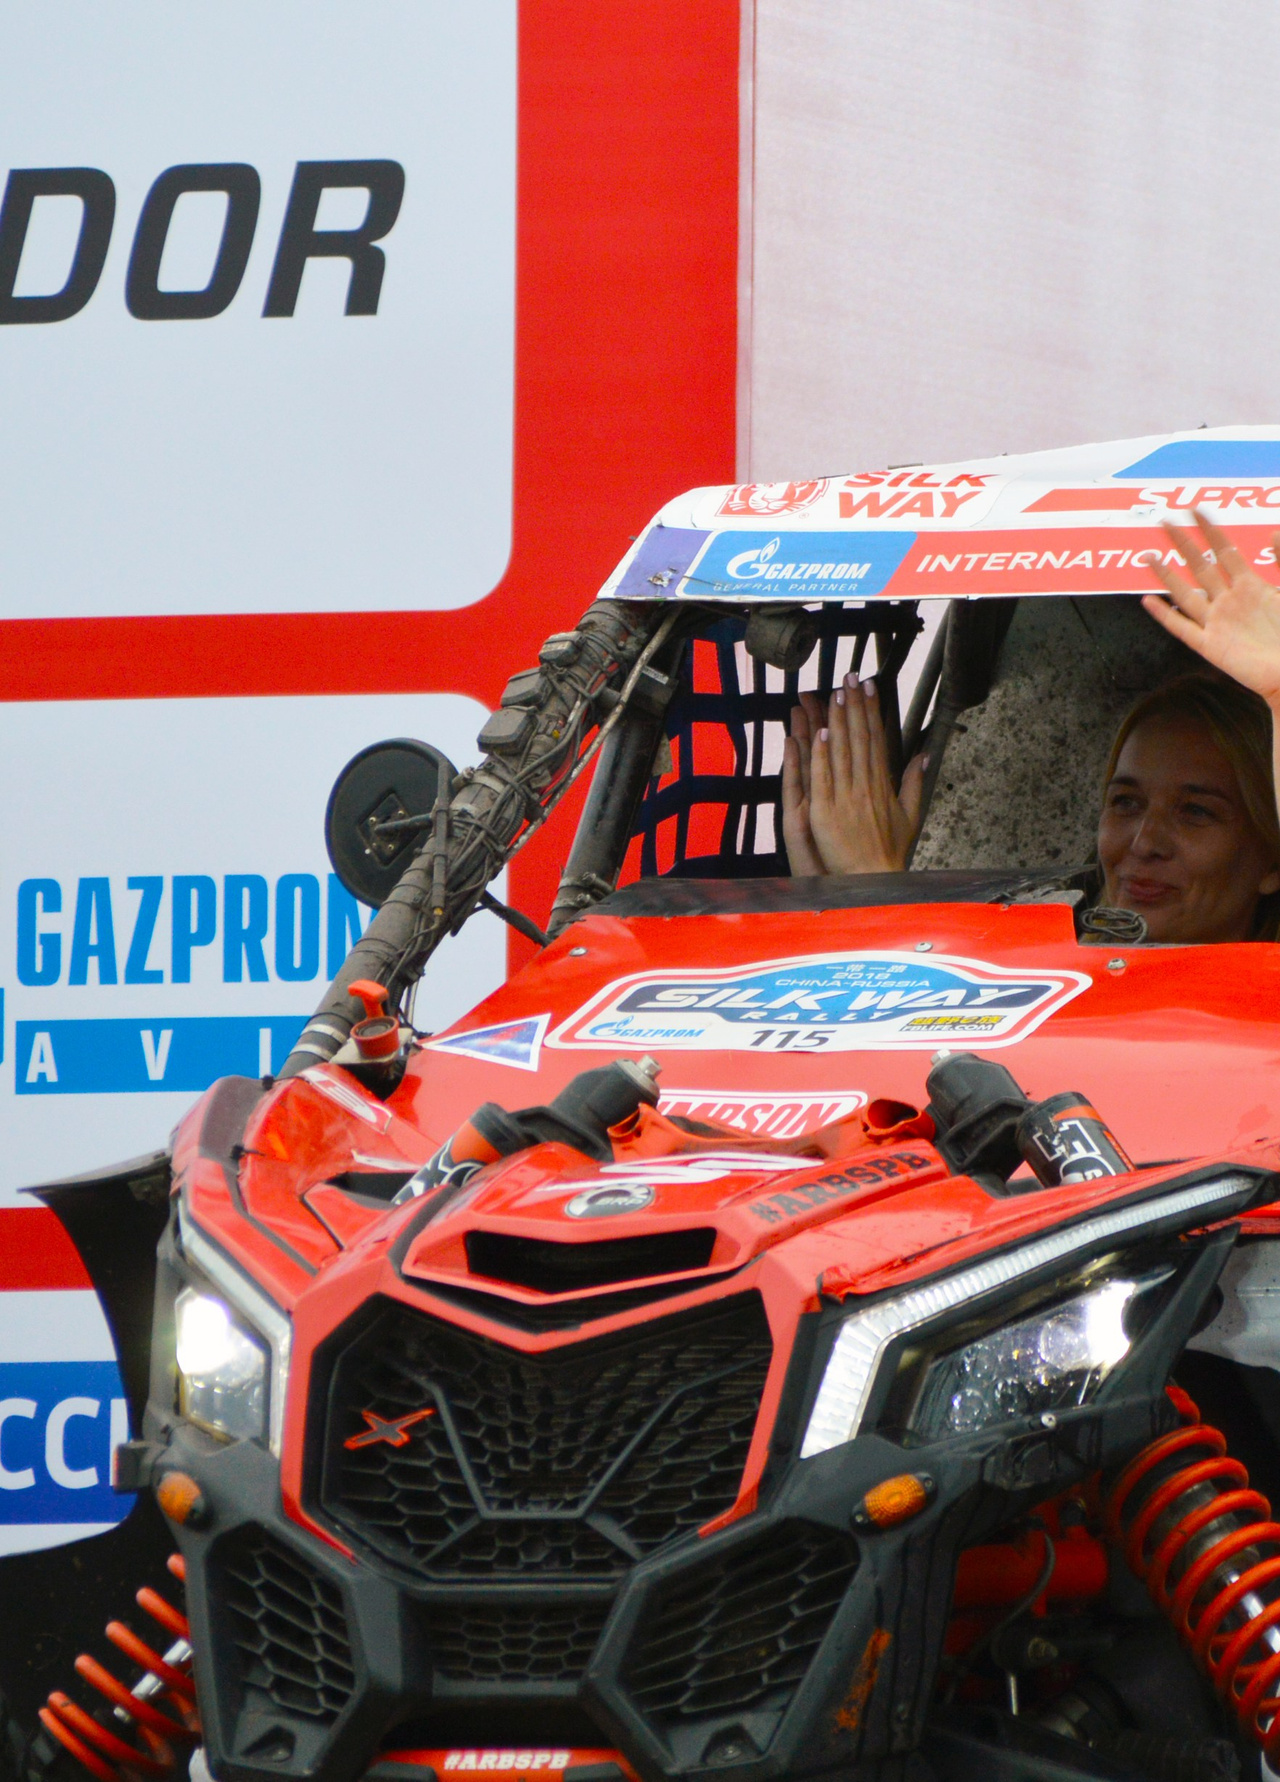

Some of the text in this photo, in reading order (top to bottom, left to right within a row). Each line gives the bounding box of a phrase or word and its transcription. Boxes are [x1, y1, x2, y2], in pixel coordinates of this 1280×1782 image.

[0, 158, 405, 325] DOR
[844, 470, 1002, 488] SILK
[838, 491, 983, 519] WAY
[916, 546, 1238, 573] INTERNATIONA
[764, 563, 872, 580] GAZPROM
[788, 583, 858, 592] PARTNER
[832, 972, 891, 980] 2018
[636, 987, 1032, 1011] SILK WAY
[739, 1011, 892, 1022] RALLY
[618, 1028, 705, 1038] GAZPROM
[901, 1024, 995, 1032] FBLIFE.COM
[749, 1029, 837, 1049] 115
[748, 1152, 932, 1224] #ARBSPB
[443, 1750, 571, 1770] #ARBSPB
